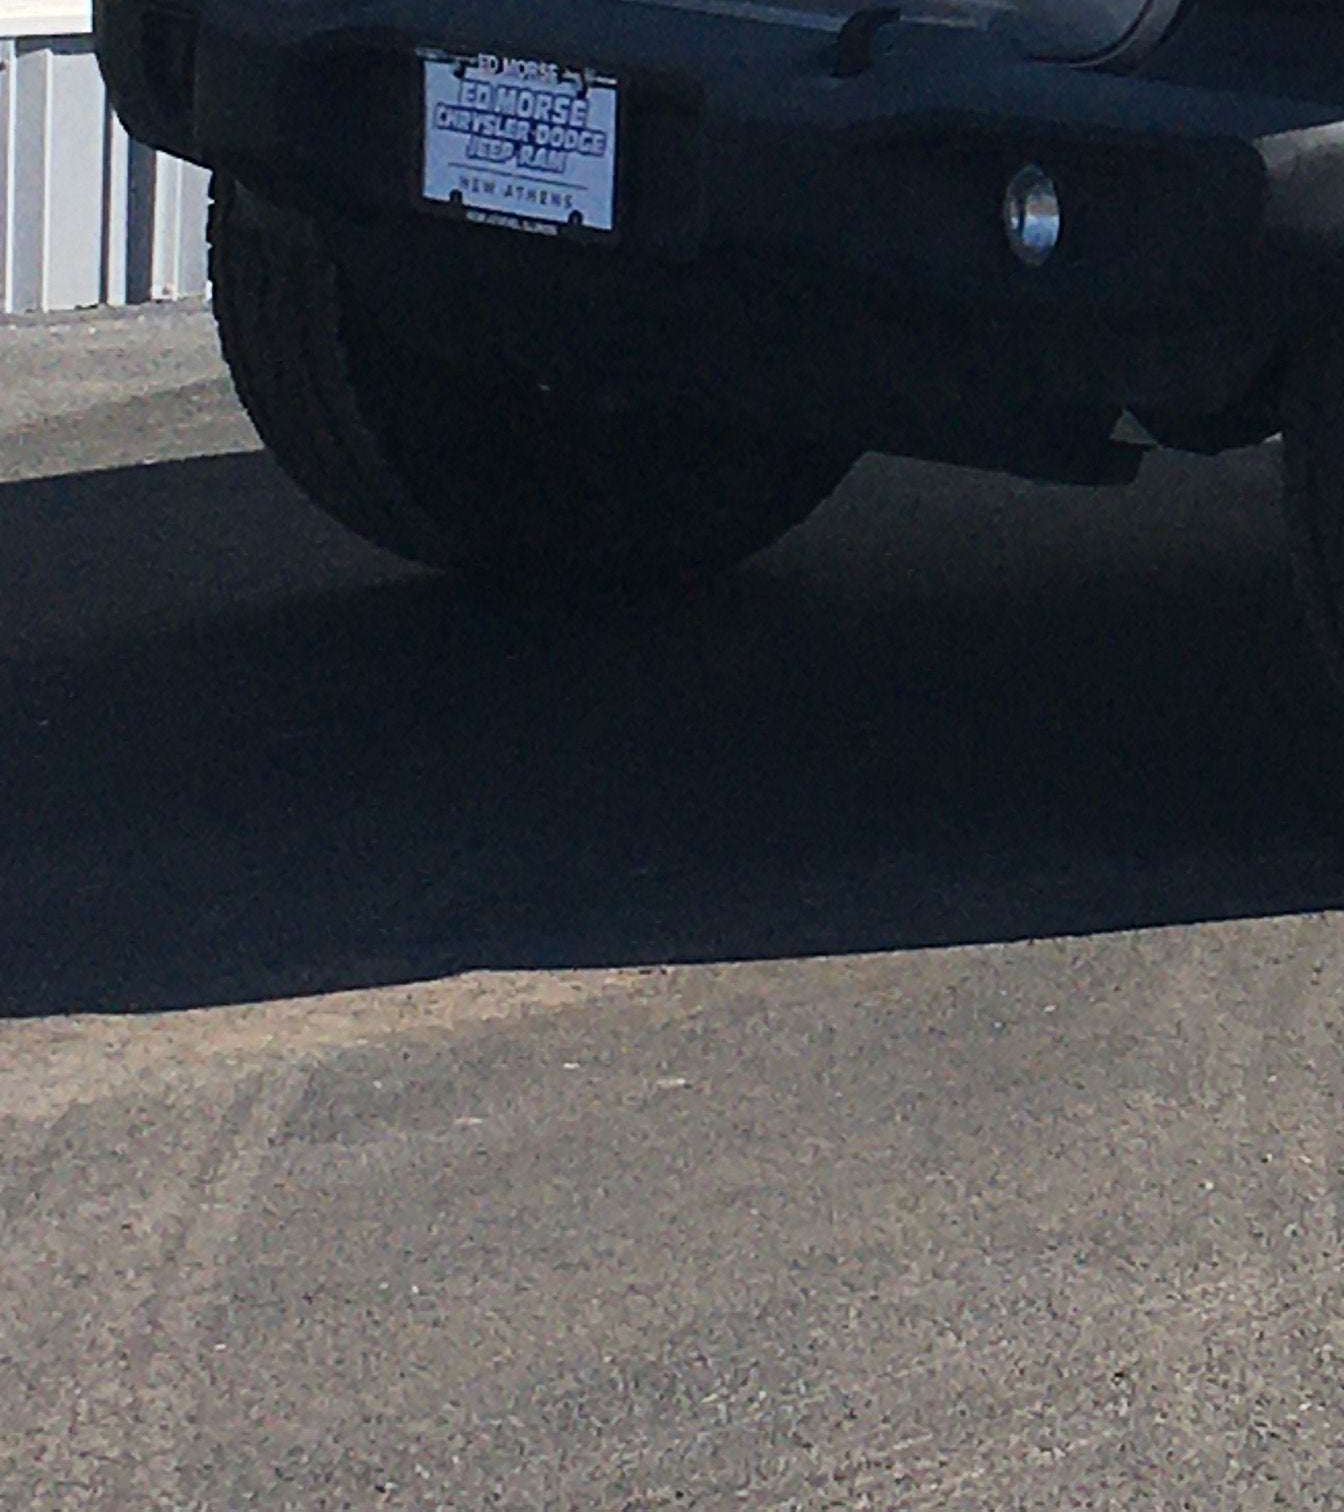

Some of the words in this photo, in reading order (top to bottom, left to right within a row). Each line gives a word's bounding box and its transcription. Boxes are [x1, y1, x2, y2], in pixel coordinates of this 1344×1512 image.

[461, 80, 492, 110] ED
[494, 86, 588, 126] MORSE
[535, 123, 607, 156] DODGE
